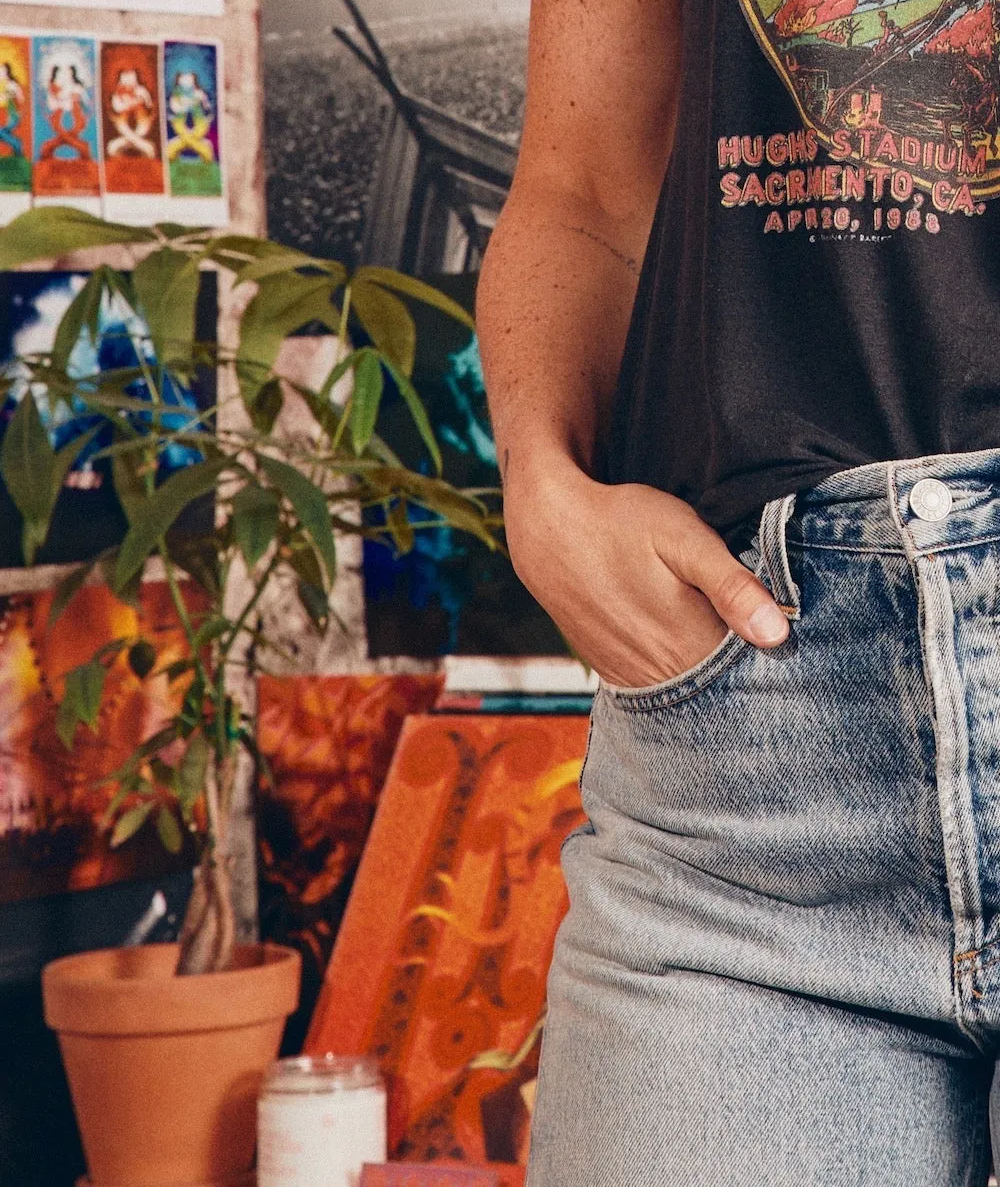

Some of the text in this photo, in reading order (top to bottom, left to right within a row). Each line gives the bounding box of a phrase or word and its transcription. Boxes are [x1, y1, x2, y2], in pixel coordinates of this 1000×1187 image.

[828, 129, 988, 178] STADIUM
[931, 180, 987, 216] CA.
[873, 206, 942, 234] 1988
